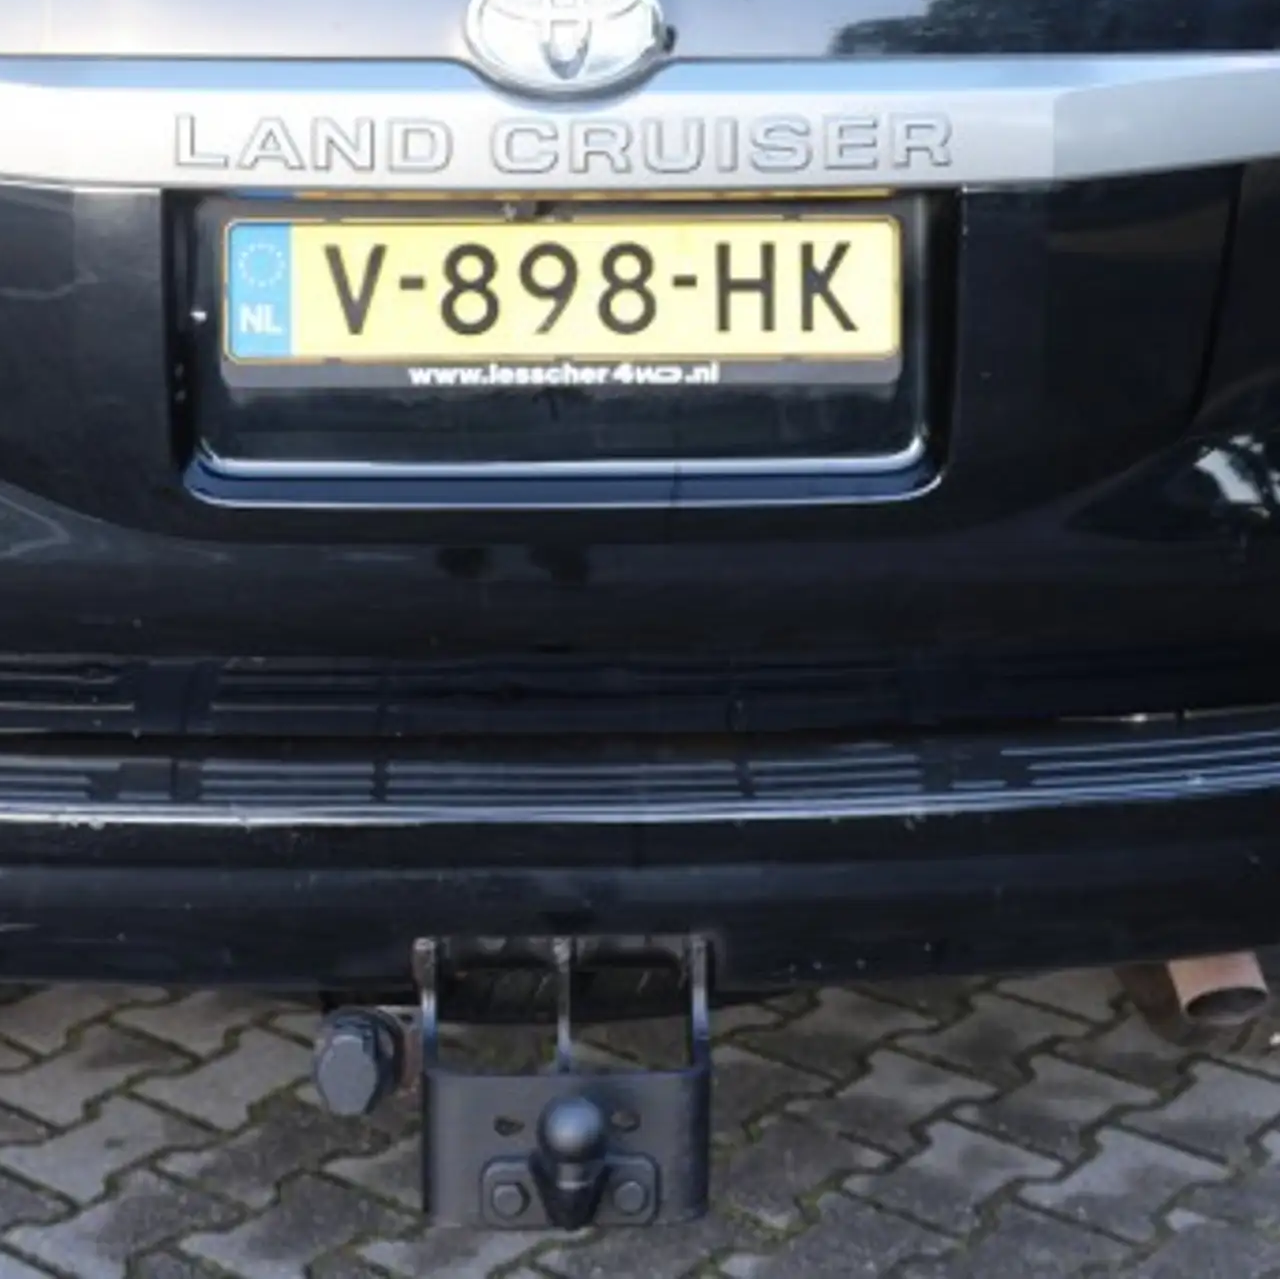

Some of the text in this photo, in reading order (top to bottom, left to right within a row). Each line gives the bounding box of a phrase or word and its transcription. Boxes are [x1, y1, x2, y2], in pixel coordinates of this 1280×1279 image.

[173, 113, 955, 174] LAND CRUISER
[240, 303, 283, 335] NL
[323, 241, 859, 336] V-898-HK
